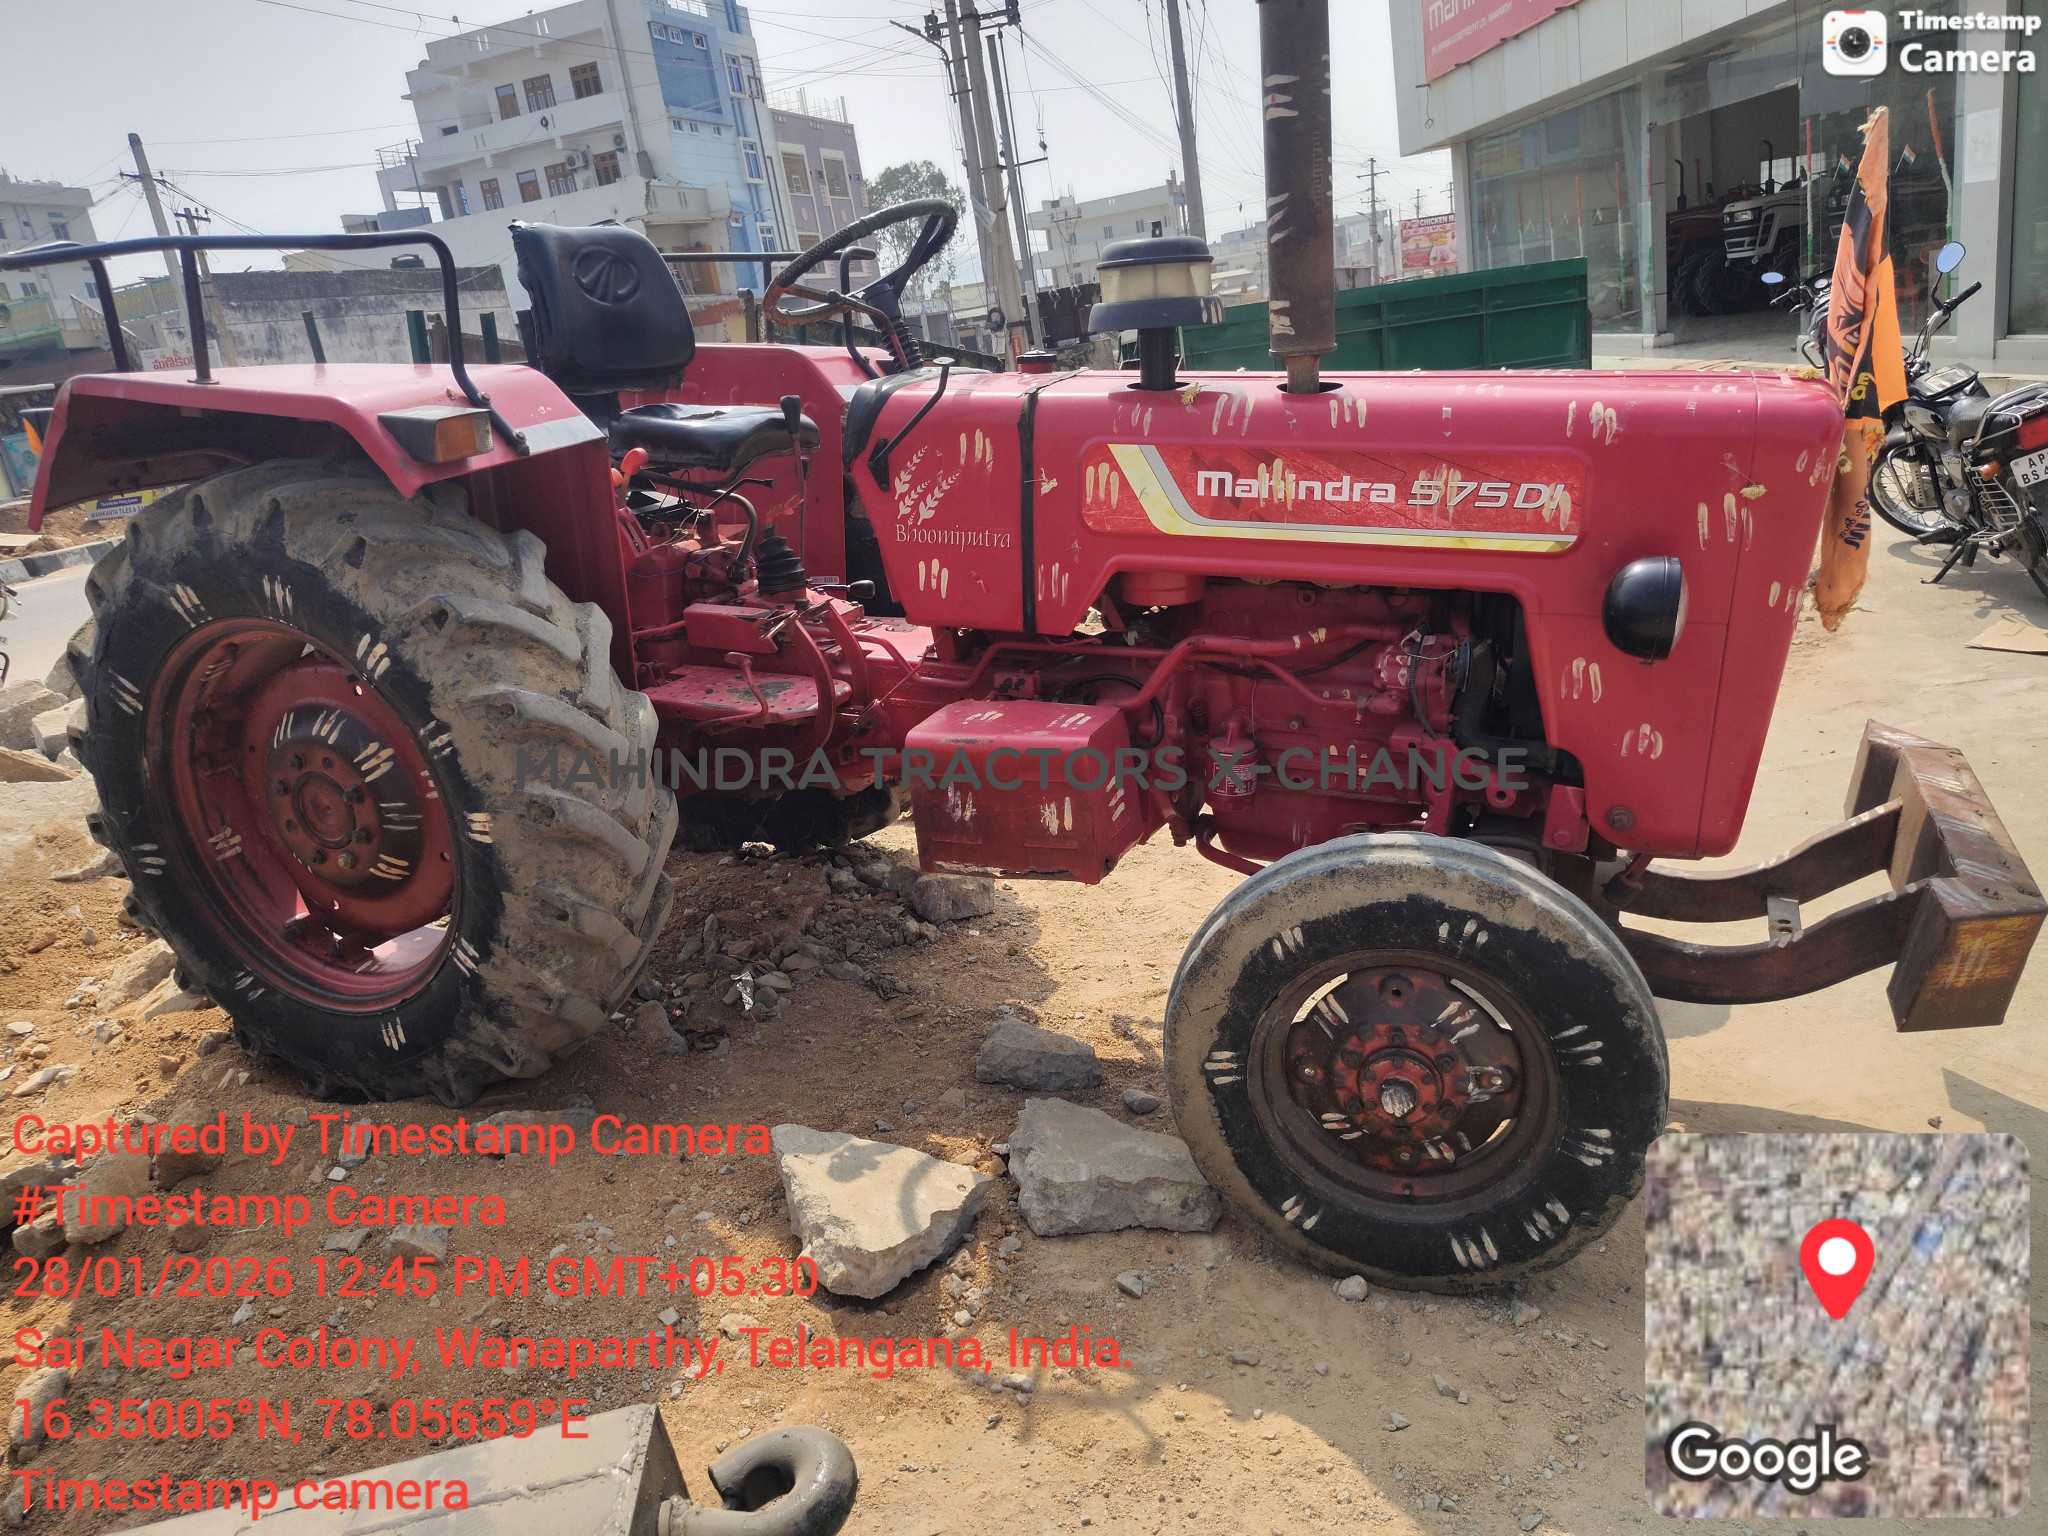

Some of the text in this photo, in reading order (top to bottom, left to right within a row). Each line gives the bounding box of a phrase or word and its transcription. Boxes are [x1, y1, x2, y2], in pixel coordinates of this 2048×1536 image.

[1419, 215, 1448, 227] CHICKEN
[90, 508, 118, 518] MANIKANTA
[119, 506, 132, 515] TILES
[132, 505, 137, 513] &
[895, 523, 1011, 552] Bhoomiputra
